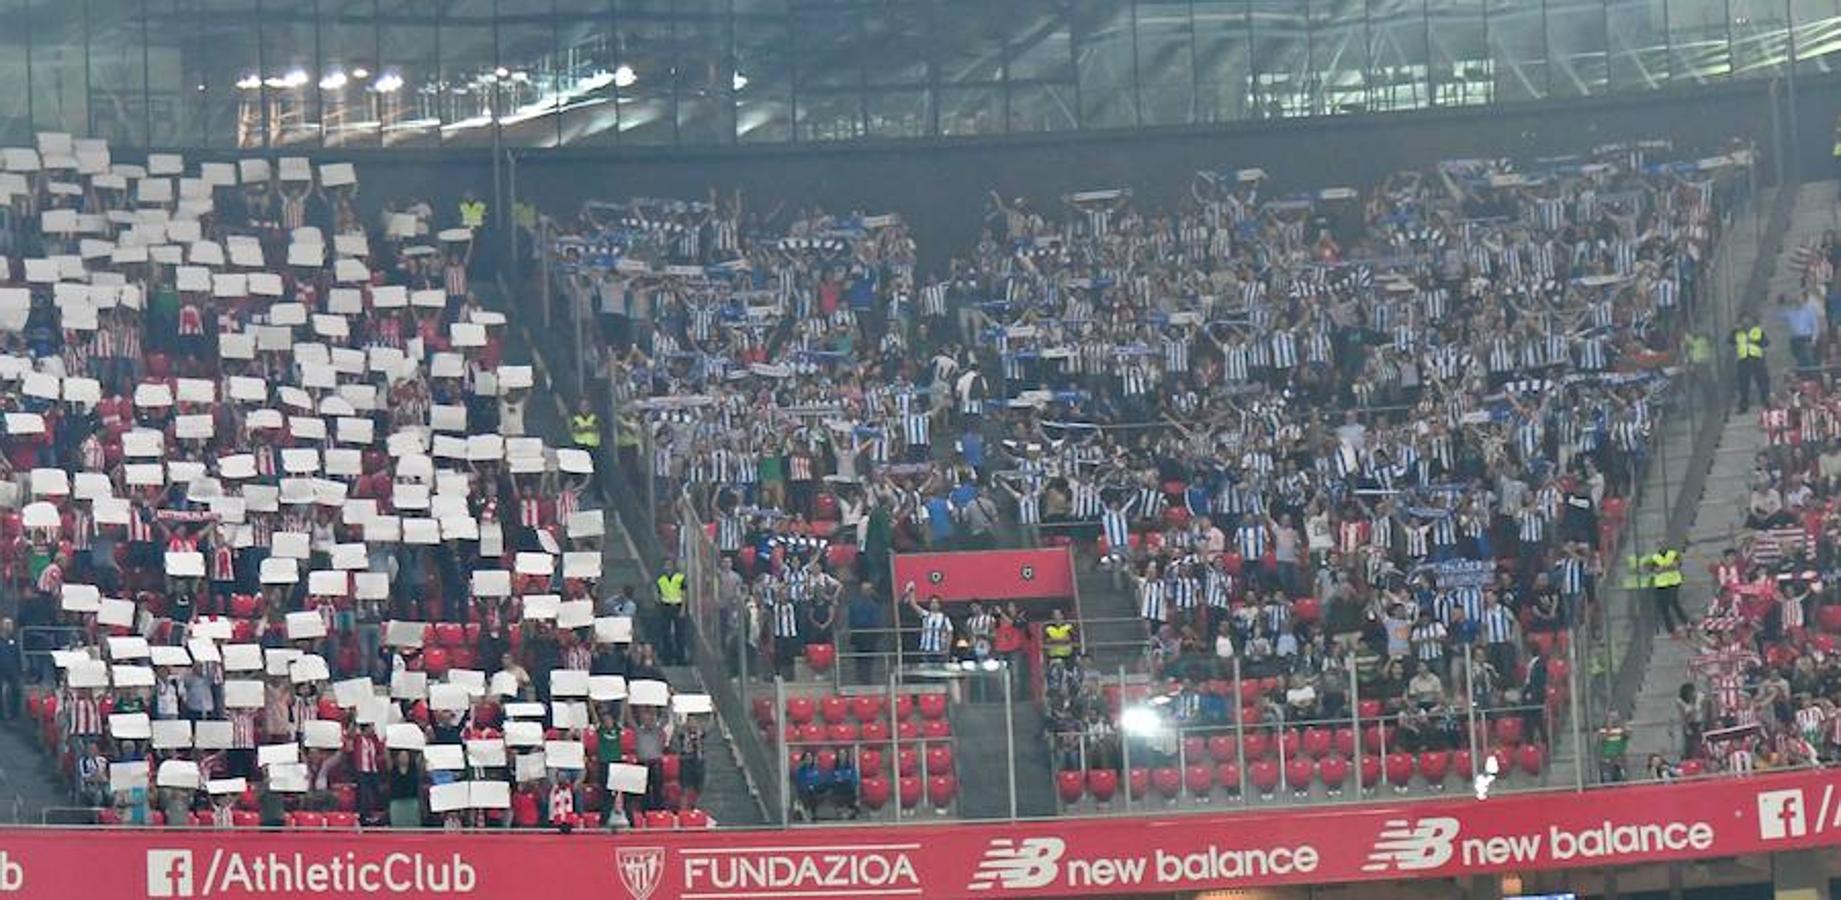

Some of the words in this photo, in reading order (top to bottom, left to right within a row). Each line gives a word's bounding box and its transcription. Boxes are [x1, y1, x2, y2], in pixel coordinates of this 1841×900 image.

[1462, 834, 1541, 866] new
[1550, 820, 1714, 860] balance
[202, 848, 476, 897] /AthleticClub
[684, 854, 919, 889] FUNDAZIOA
[1068, 857, 1147, 887] new
[1155, 846, 1320, 882] balance
